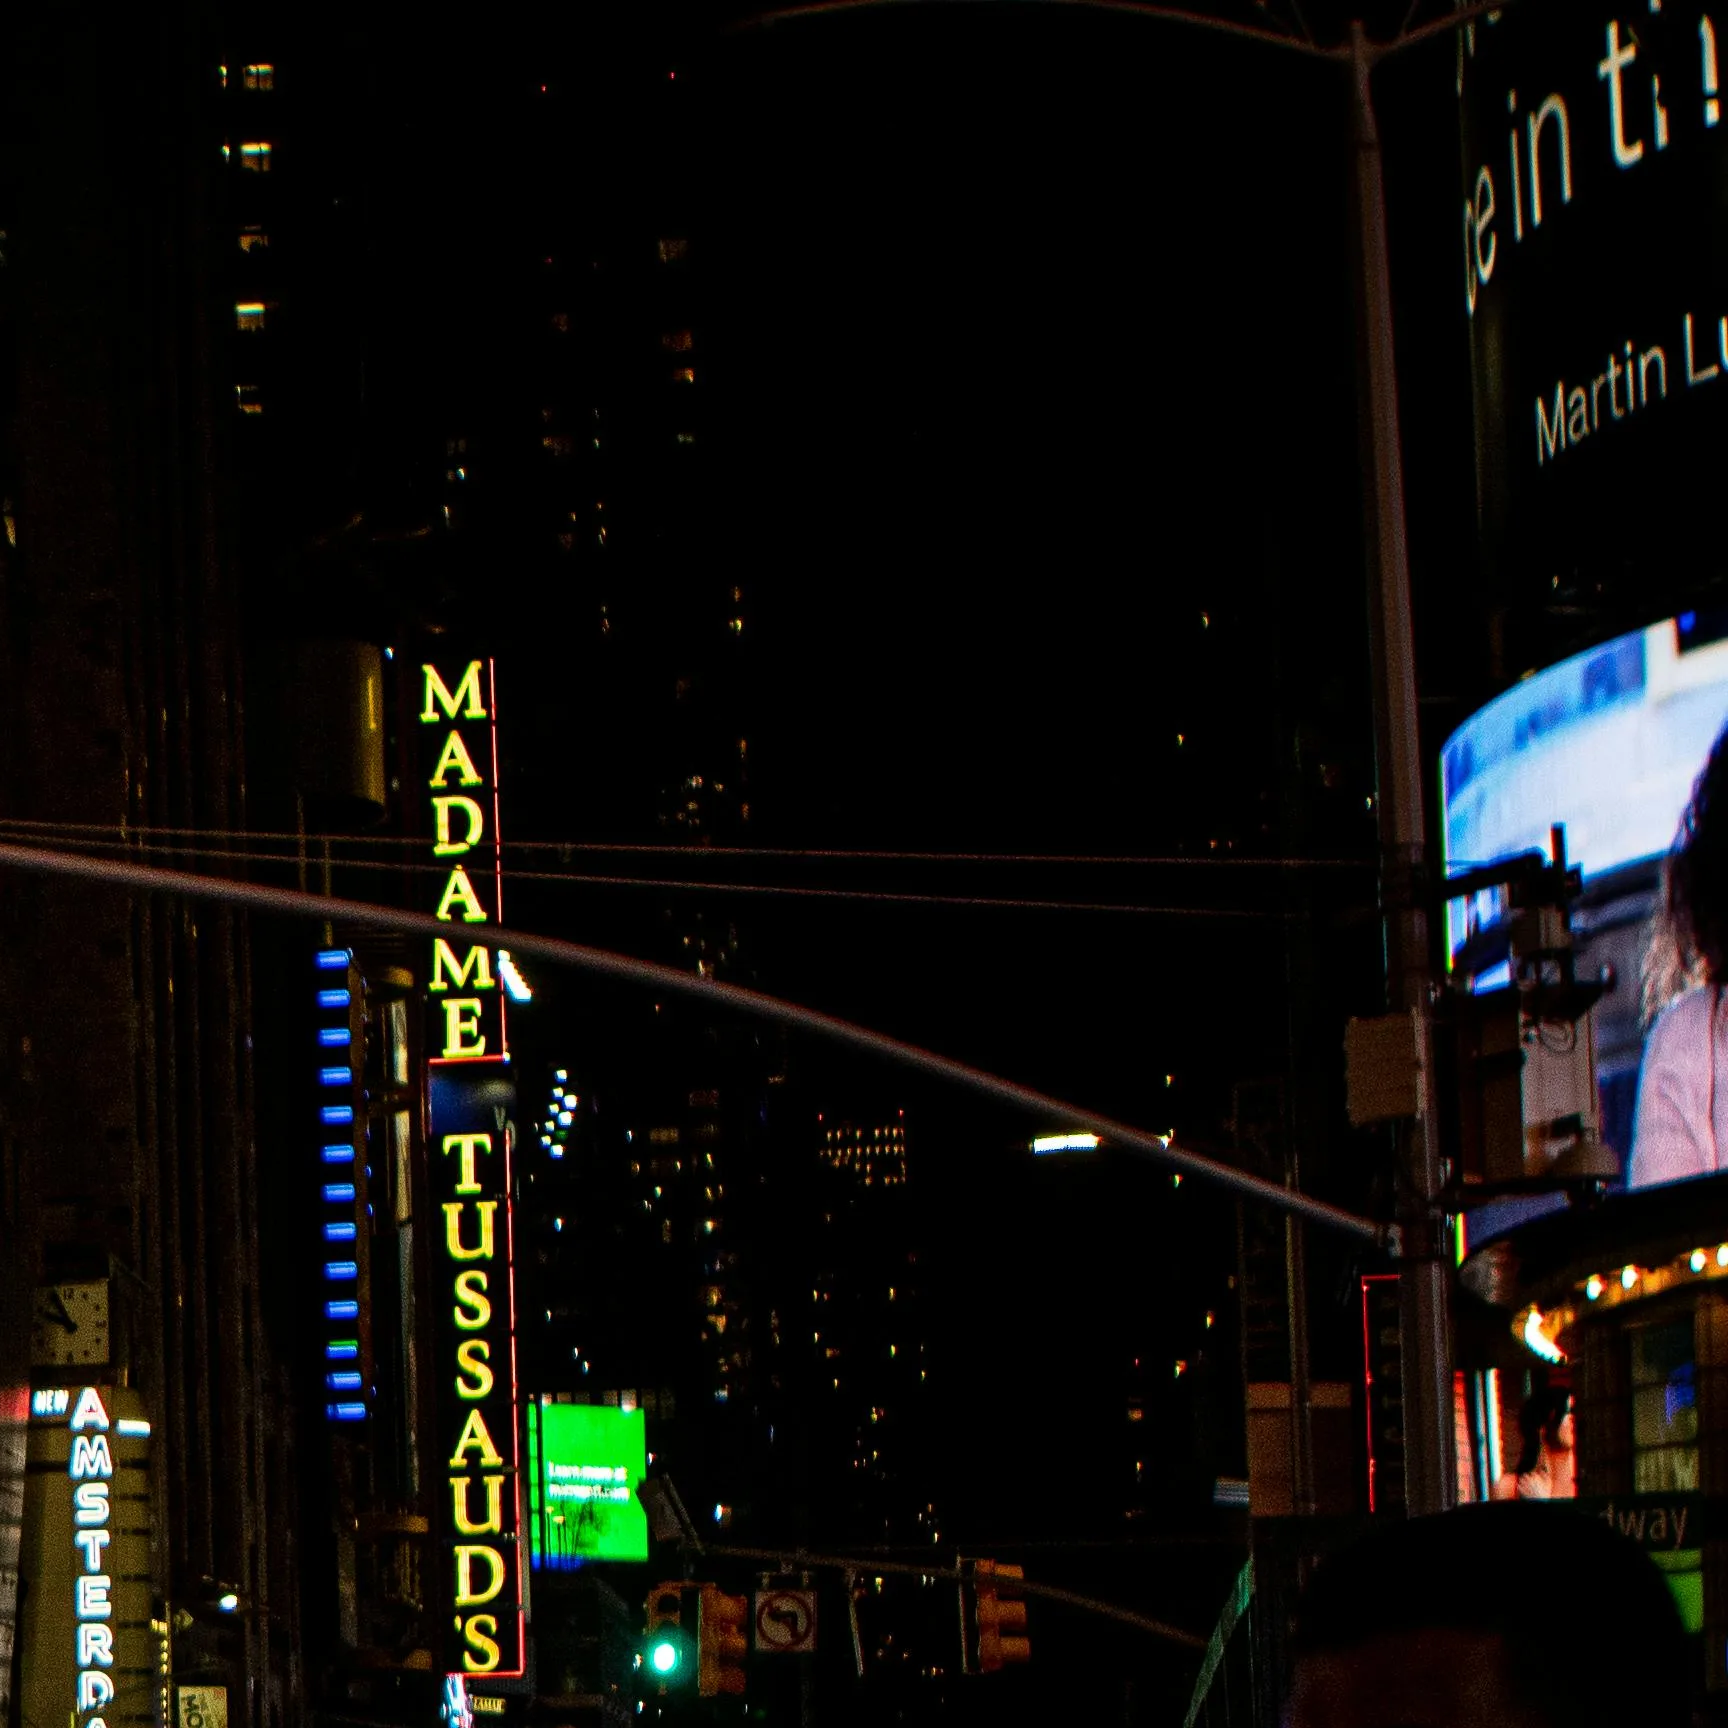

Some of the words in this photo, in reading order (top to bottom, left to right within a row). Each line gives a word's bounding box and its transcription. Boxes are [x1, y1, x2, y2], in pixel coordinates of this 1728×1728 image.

[1506, 86, 1574, 244] in
[1533, 339, 1668, 468] Martin
[420, 660, 495, 1058] MADAME
[32, 1389, 69, 1416] NEW
